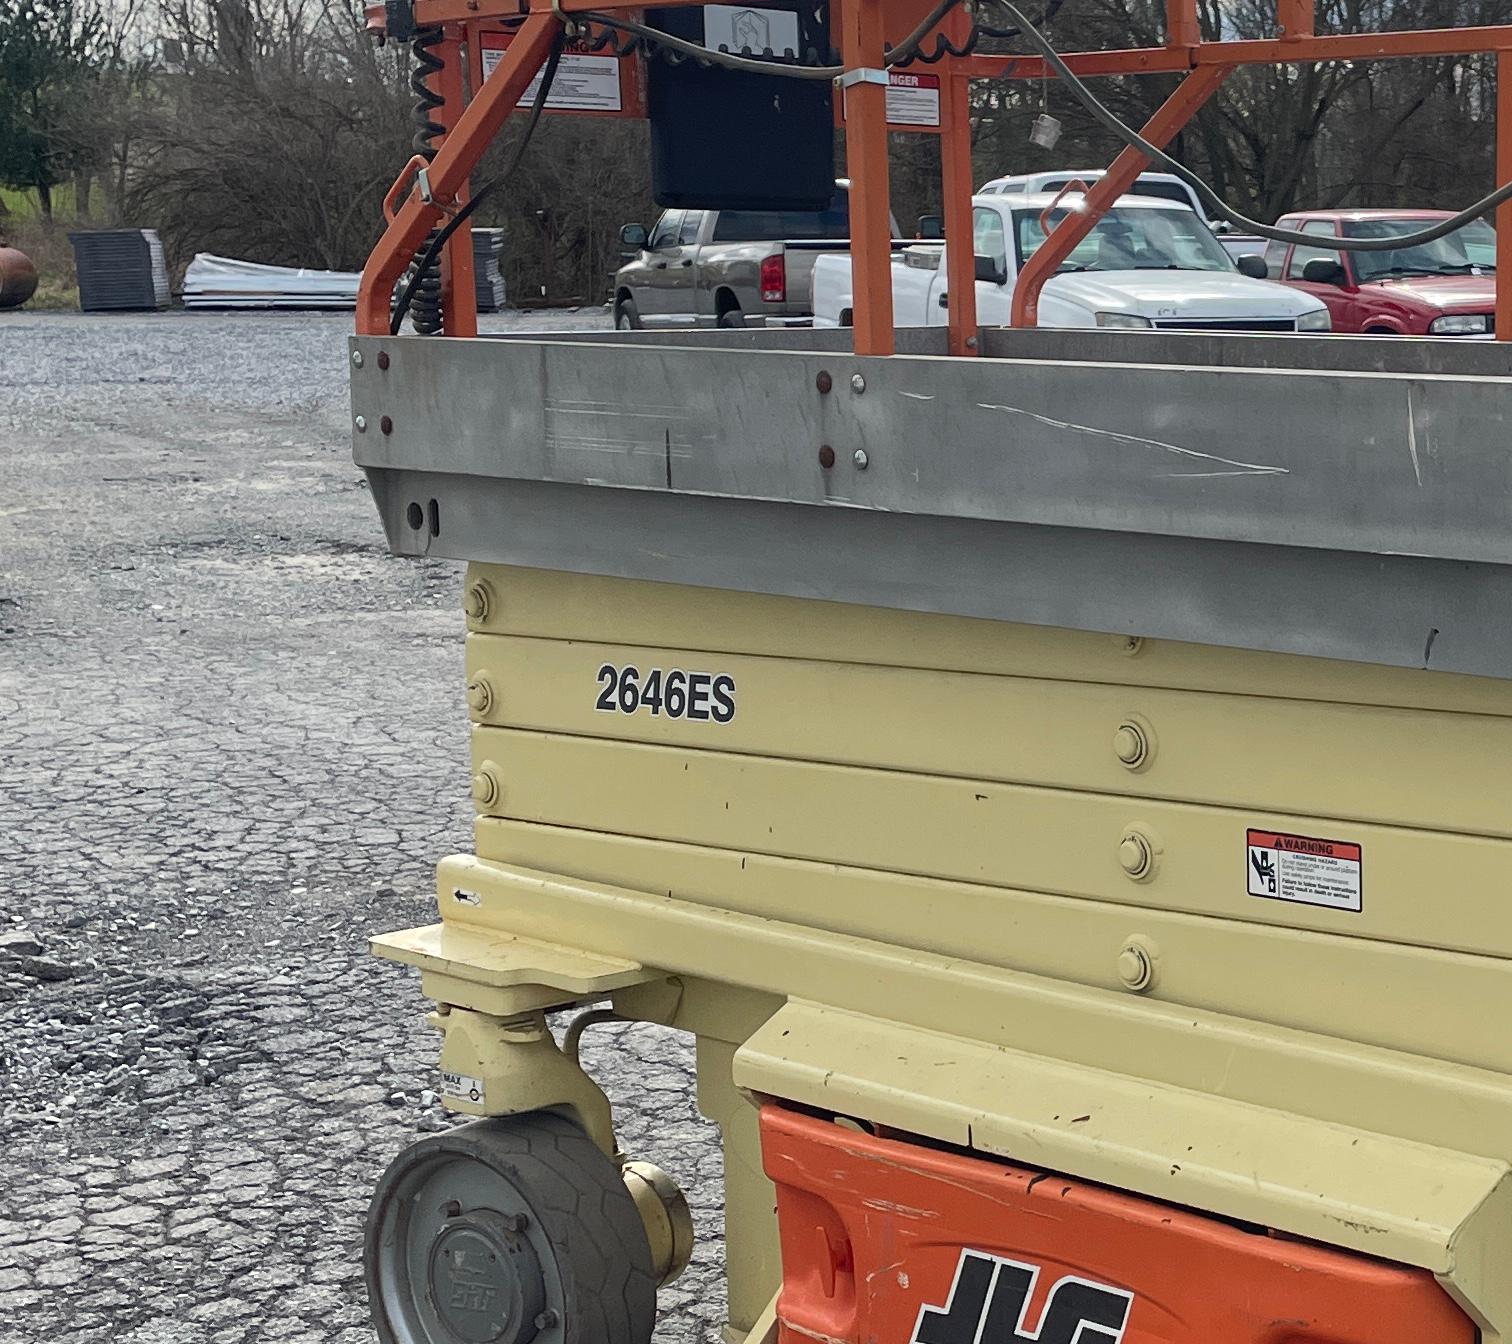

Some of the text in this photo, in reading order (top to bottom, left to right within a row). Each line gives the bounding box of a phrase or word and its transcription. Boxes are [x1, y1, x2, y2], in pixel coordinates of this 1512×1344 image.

[890, 75, 918, 86] NGER
[596, 665, 735, 723] 2646ES
[1284, 838, 1333, 855] WARNING
